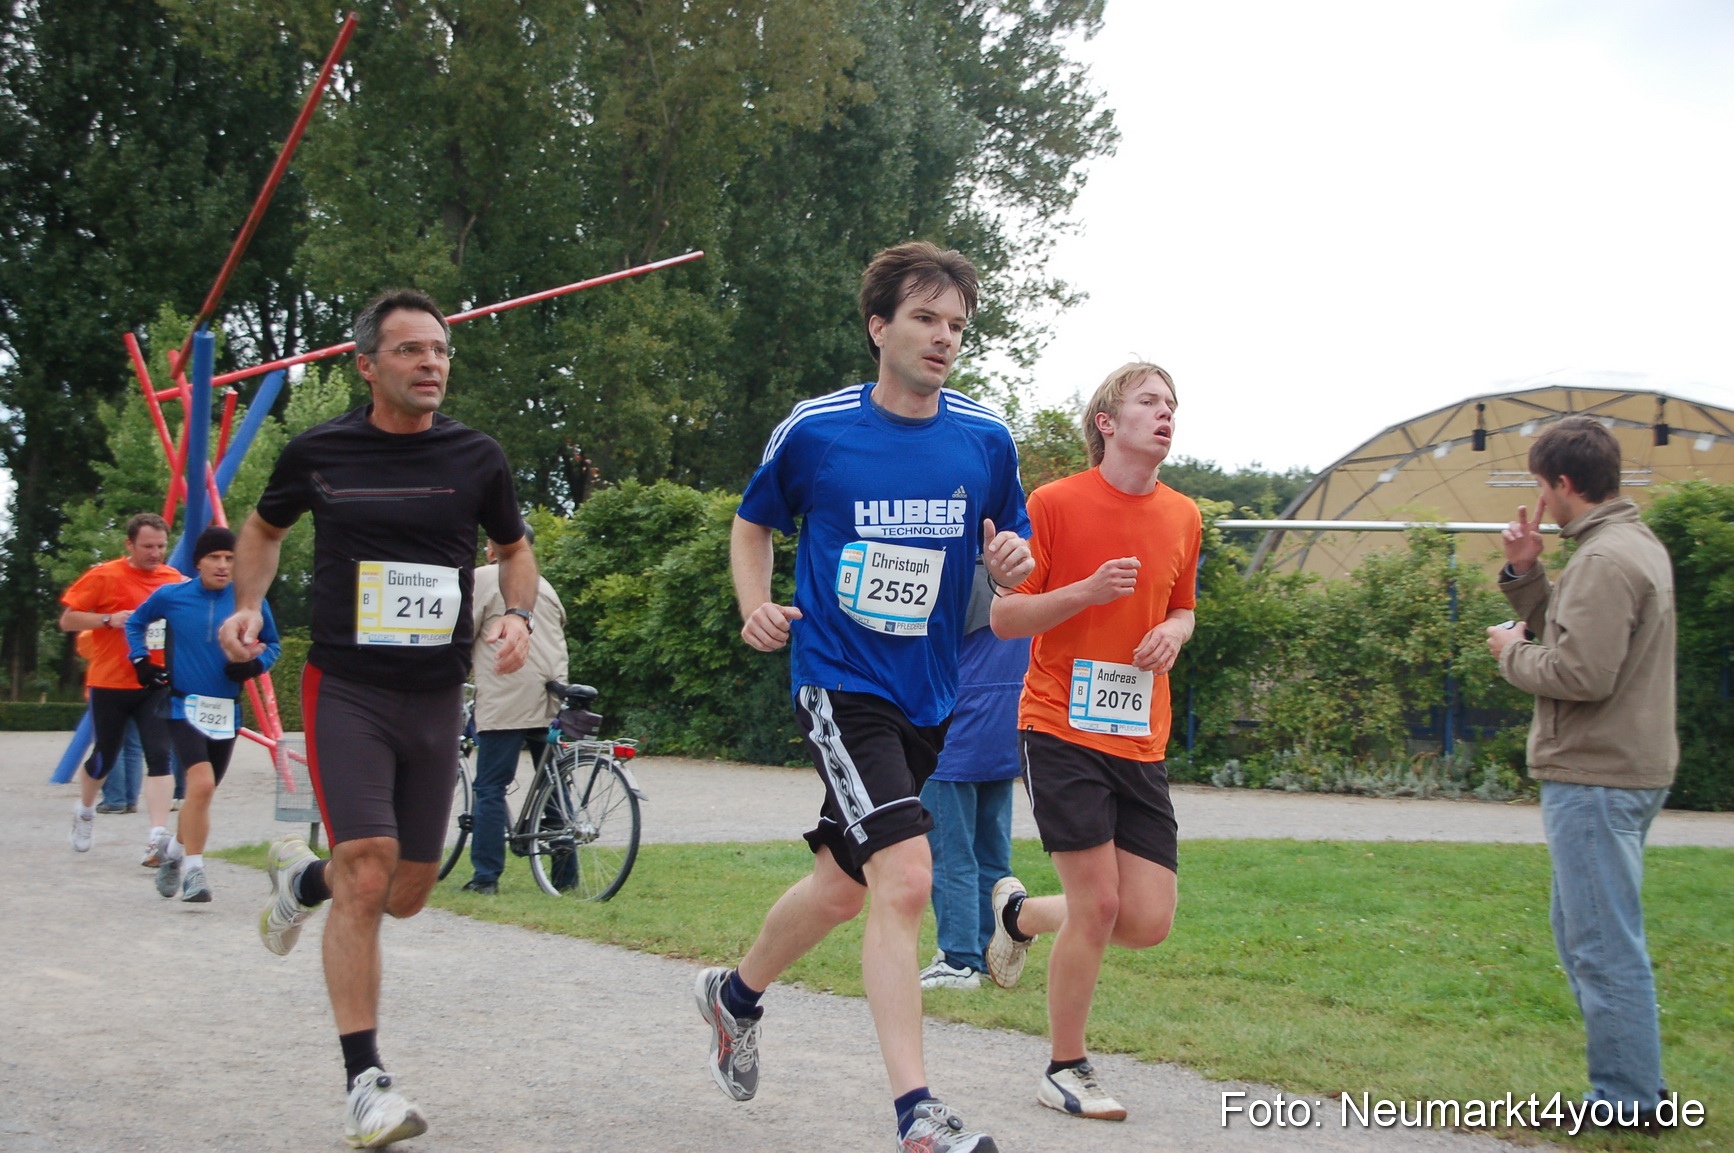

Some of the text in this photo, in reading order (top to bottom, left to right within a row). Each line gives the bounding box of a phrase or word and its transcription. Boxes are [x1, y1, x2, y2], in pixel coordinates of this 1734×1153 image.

[854, 499, 967, 525] HUBER
[881, 526, 960, 536] TECHNOLOGY
[871, 552, 930, 576] Christoph
[388, 569, 439, 588] Günther
[844, 572, 852, 584] B
[363, 593, 370, 605] B
[867, 578, 928, 606] 2552
[396, 596, 443, 619] 214
[1097, 668, 1137, 685] Andreas
[1077, 685, 1084, 696] B
[1096, 689, 1143, 711] 2076
[199, 712, 228, 725] 2921
